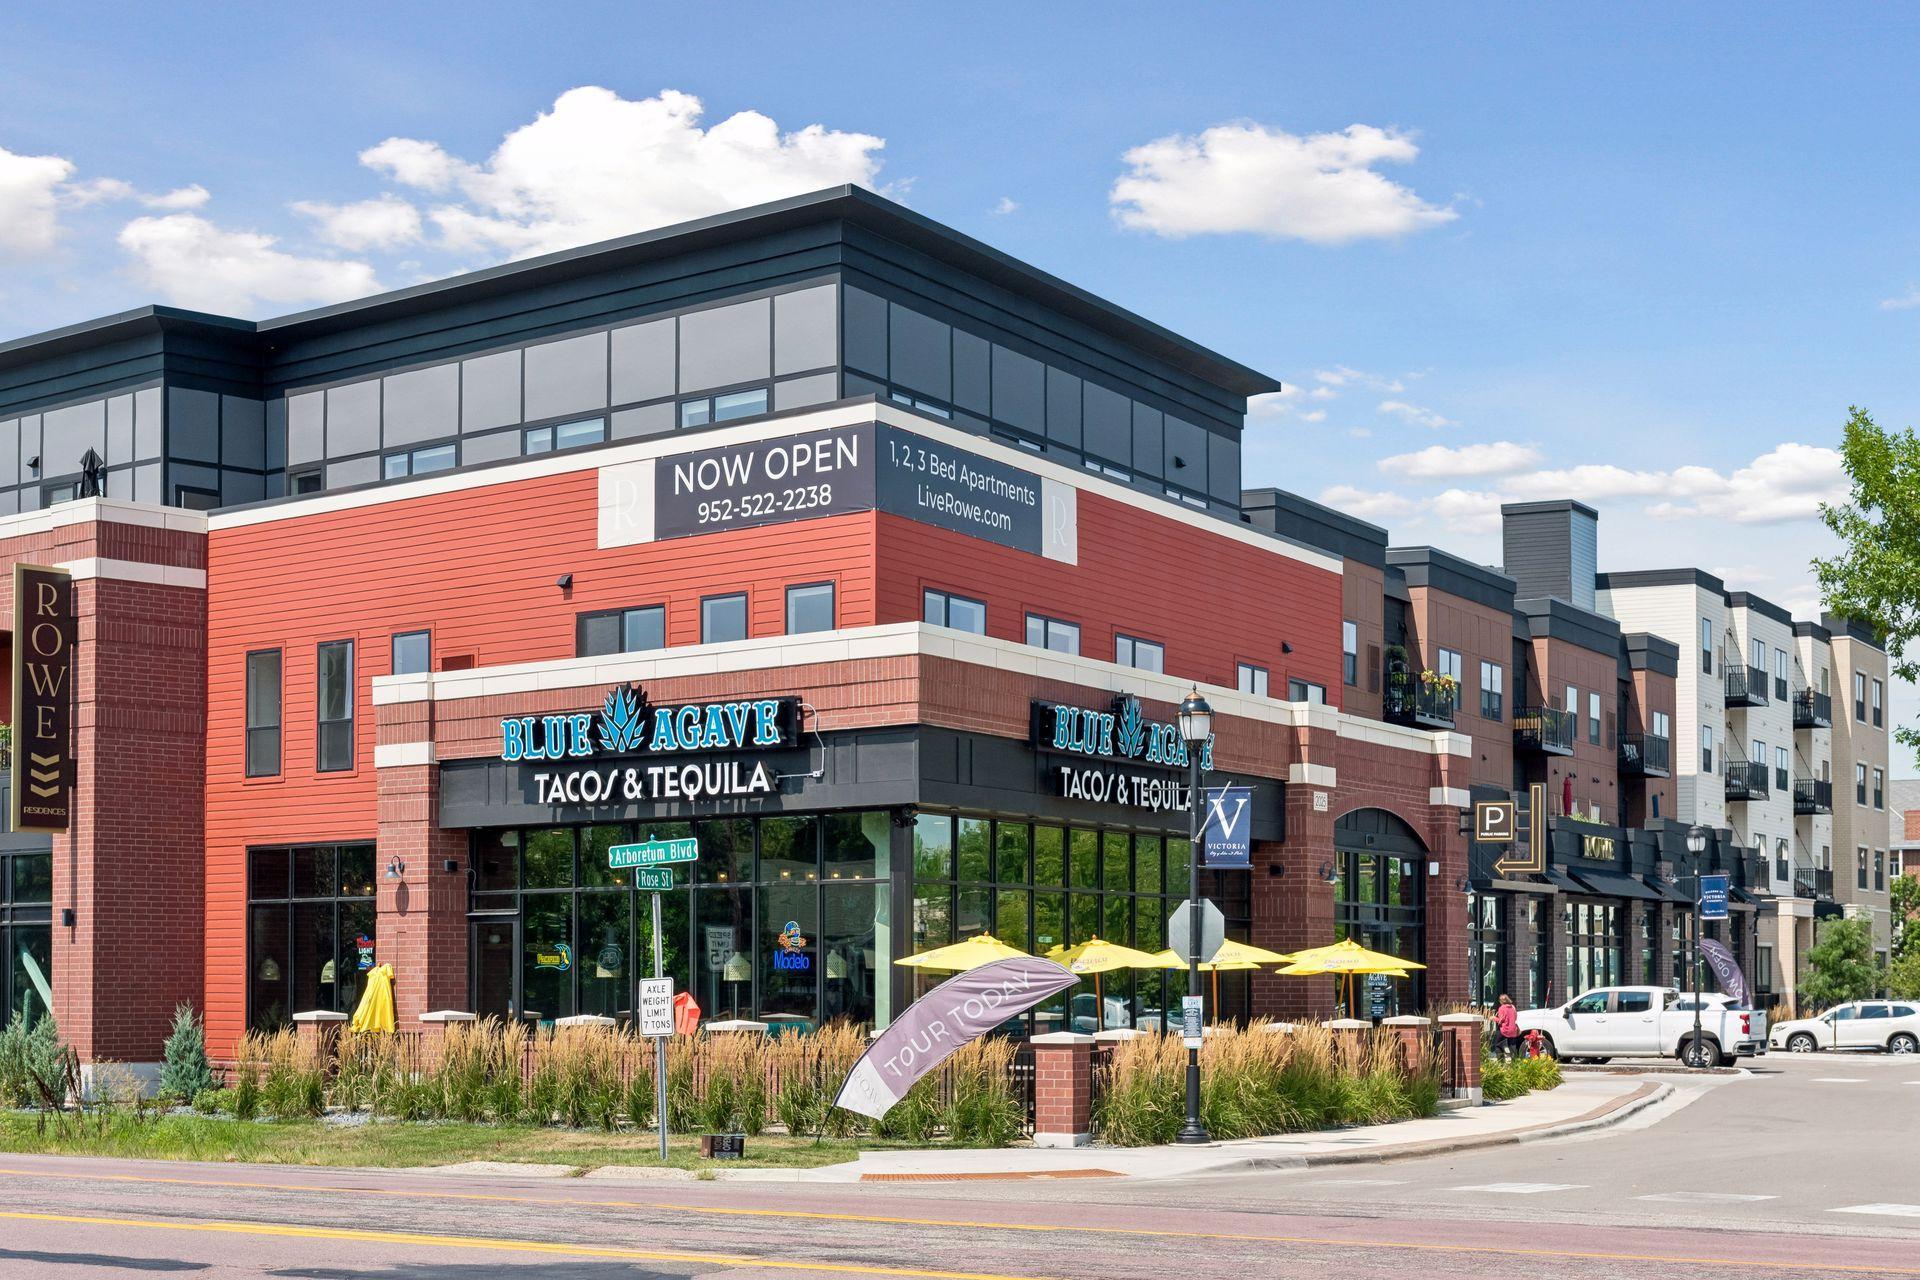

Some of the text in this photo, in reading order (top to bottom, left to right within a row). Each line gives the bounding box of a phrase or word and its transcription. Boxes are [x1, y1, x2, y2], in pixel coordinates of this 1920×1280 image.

[674, 434, 859, 495] NOW OPEN
[889, 440, 1036, 507] 1, 2, 3 Bed Apartments
[613, 479, 639, 531] R
[698, 483, 832, 524] 952-522-2238
[917, 484, 1012, 532] LiveRowe.com
[1051, 495, 1067, 547] R
[26, 582, 68, 739] ROWE
[500, 700, 782, 762] BLUE AGAVE
[1053, 704, 1215, 771] BLUE AGAE
[534, 760, 771, 804] TACOS & TEQUILA
[1061, 766, 1115, 802] TACOS
[1116, 774, 1129, 805] &
[23, 806, 66, 816] RESIDENCES
[1209, 798, 1248, 841] V
[1485, 806, 1504, 831] P
[615, 842, 692, 865] Arboretum Blvd
[641, 871, 669, 887] Rose St
[774, 950, 810, 969] Modelo
[642, 996, 670, 1006] WEIGHT
[646, 984, 666, 994] AXLE
[1726, 977, 1743, 999] OW
[643, 1019, 671, 1029] 7 TONS
[646, 1008, 666, 1018] LIMIT
[884, 970, 1032, 1077] TOUR TODAY
